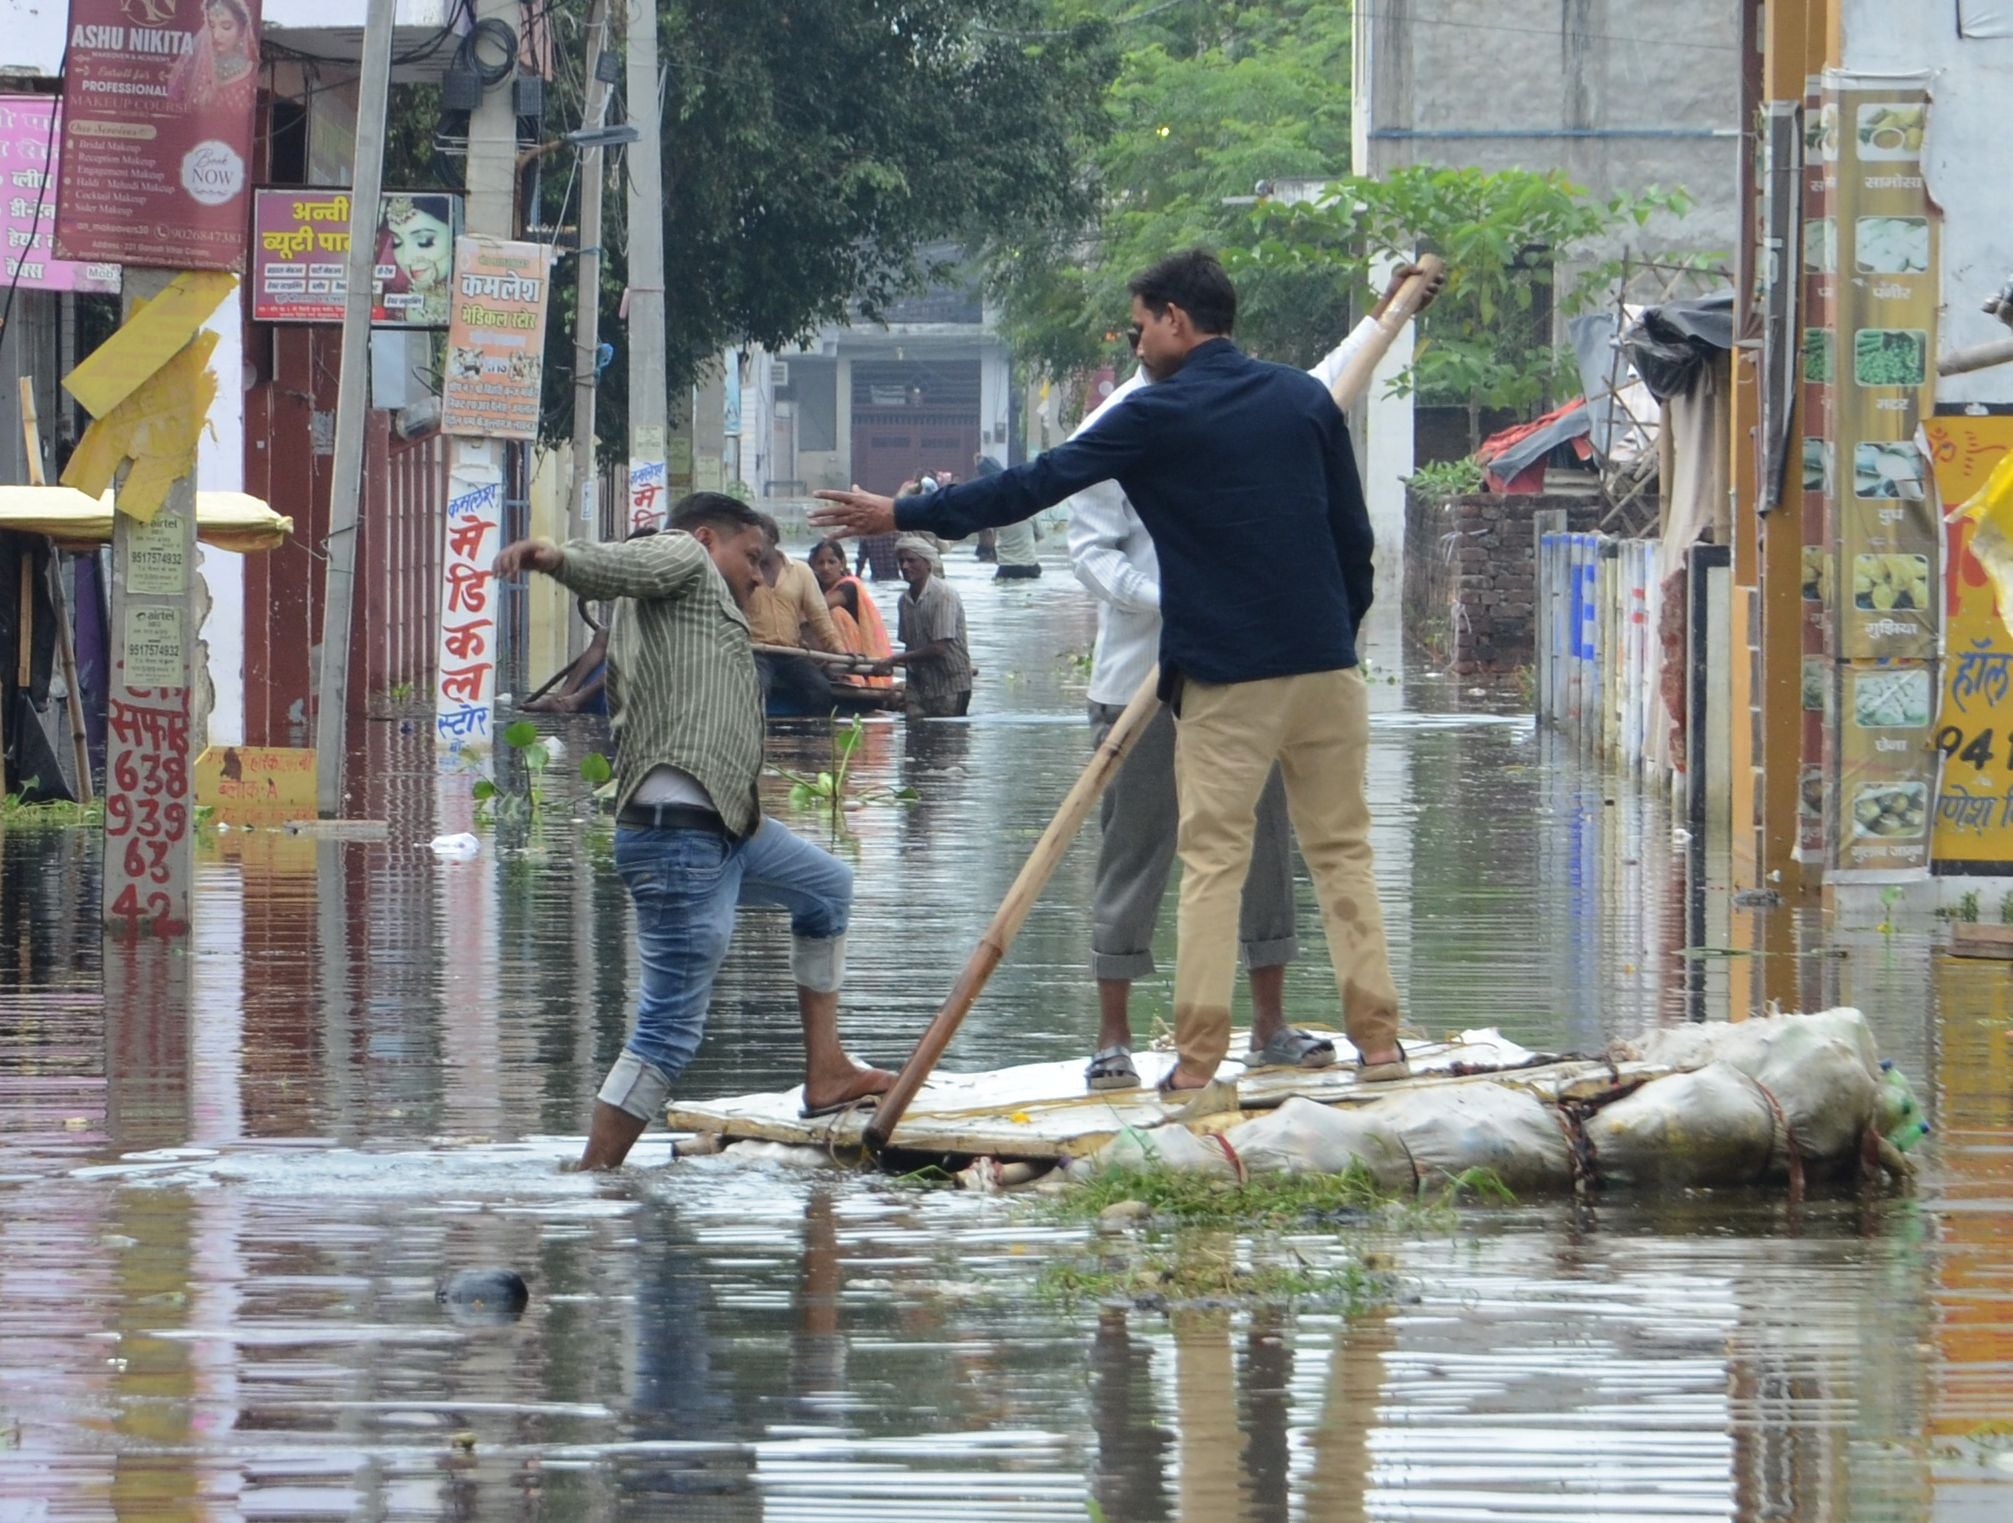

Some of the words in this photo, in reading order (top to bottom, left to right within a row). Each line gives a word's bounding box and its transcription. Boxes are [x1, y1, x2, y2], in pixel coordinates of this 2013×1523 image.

[71, 24, 124, 50] ASHU
[129, 28, 194, 55] NIKITA
[82, 80, 168, 96] PROFESSIONAL
[192, 168, 234, 185] NOW
[292, 195, 350, 221] अन्वी
[262, 225, 314, 260] ब्यूटी
[461, 269, 544, 303] कमलेश
[462, 303, 509, 328] मेडिकल
[511, 308, 537, 329] स्टोर
[148, 610, 175, 621] airtel
[438, 704, 489, 739] स्टोर
[115, 750, 188, 799] 638
[107, 793, 187, 842] 939
[124, 836, 171, 883] 63
[111, 883, 190, 938] 42
